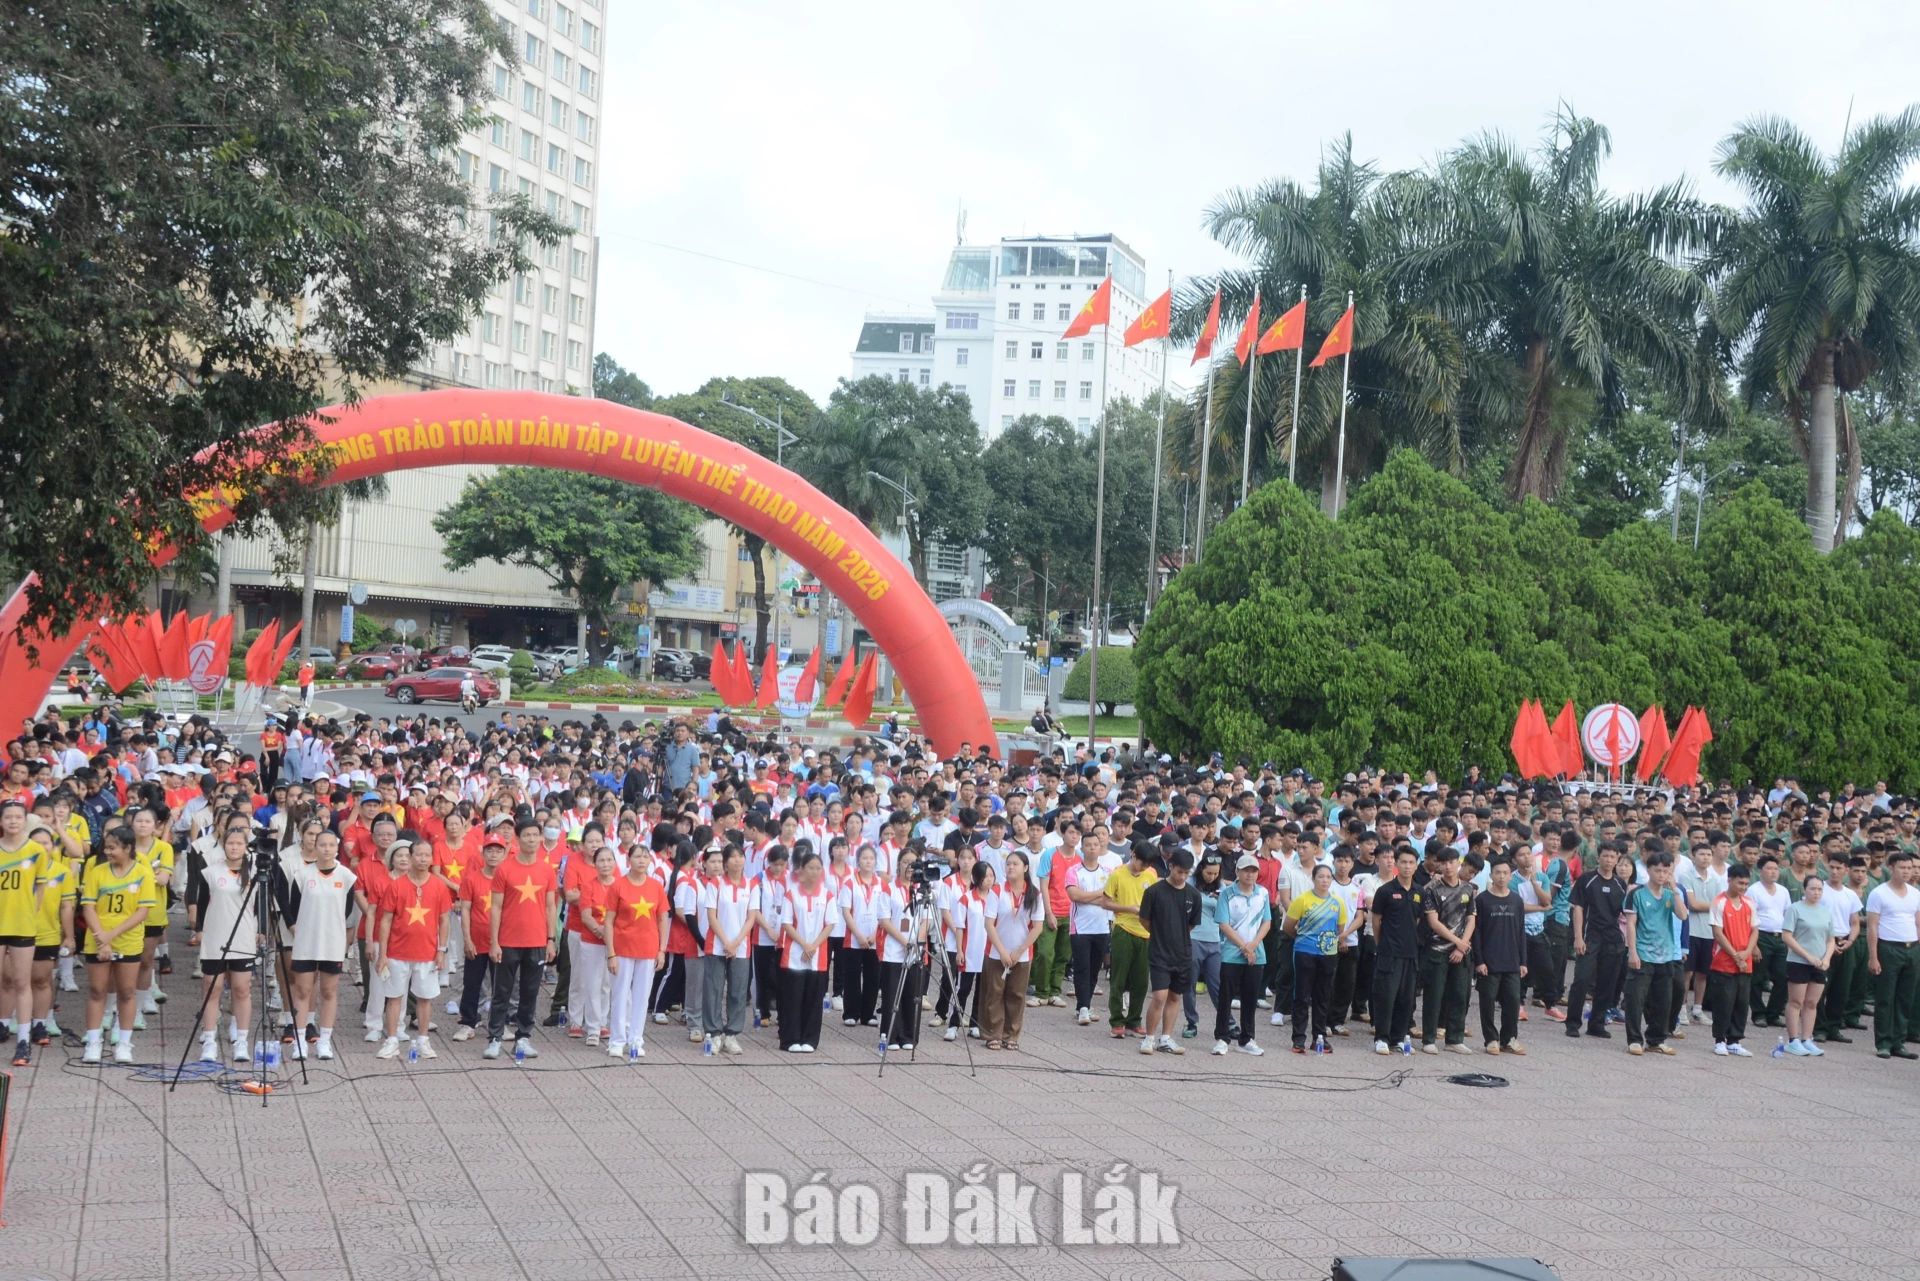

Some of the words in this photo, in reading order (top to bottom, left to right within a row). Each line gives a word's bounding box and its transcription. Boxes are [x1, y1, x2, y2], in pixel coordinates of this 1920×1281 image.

[379, 418, 445, 455] TRÀO
[448, 412, 514, 446] TOÀN
[519, 415, 570, 449] DÂN
[575, 421, 619, 457] TẬP
[620, 435, 697, 478] LUYỆN
[697, 456, 748, 495] THỂ
[739, 477, 798, 525] THAO
[791, 511, 846, 561] NĂM
[836, 549, 890, 601] 2026
[0, 870, 20, 890] 20
[107, 893, 124, 914] 13
